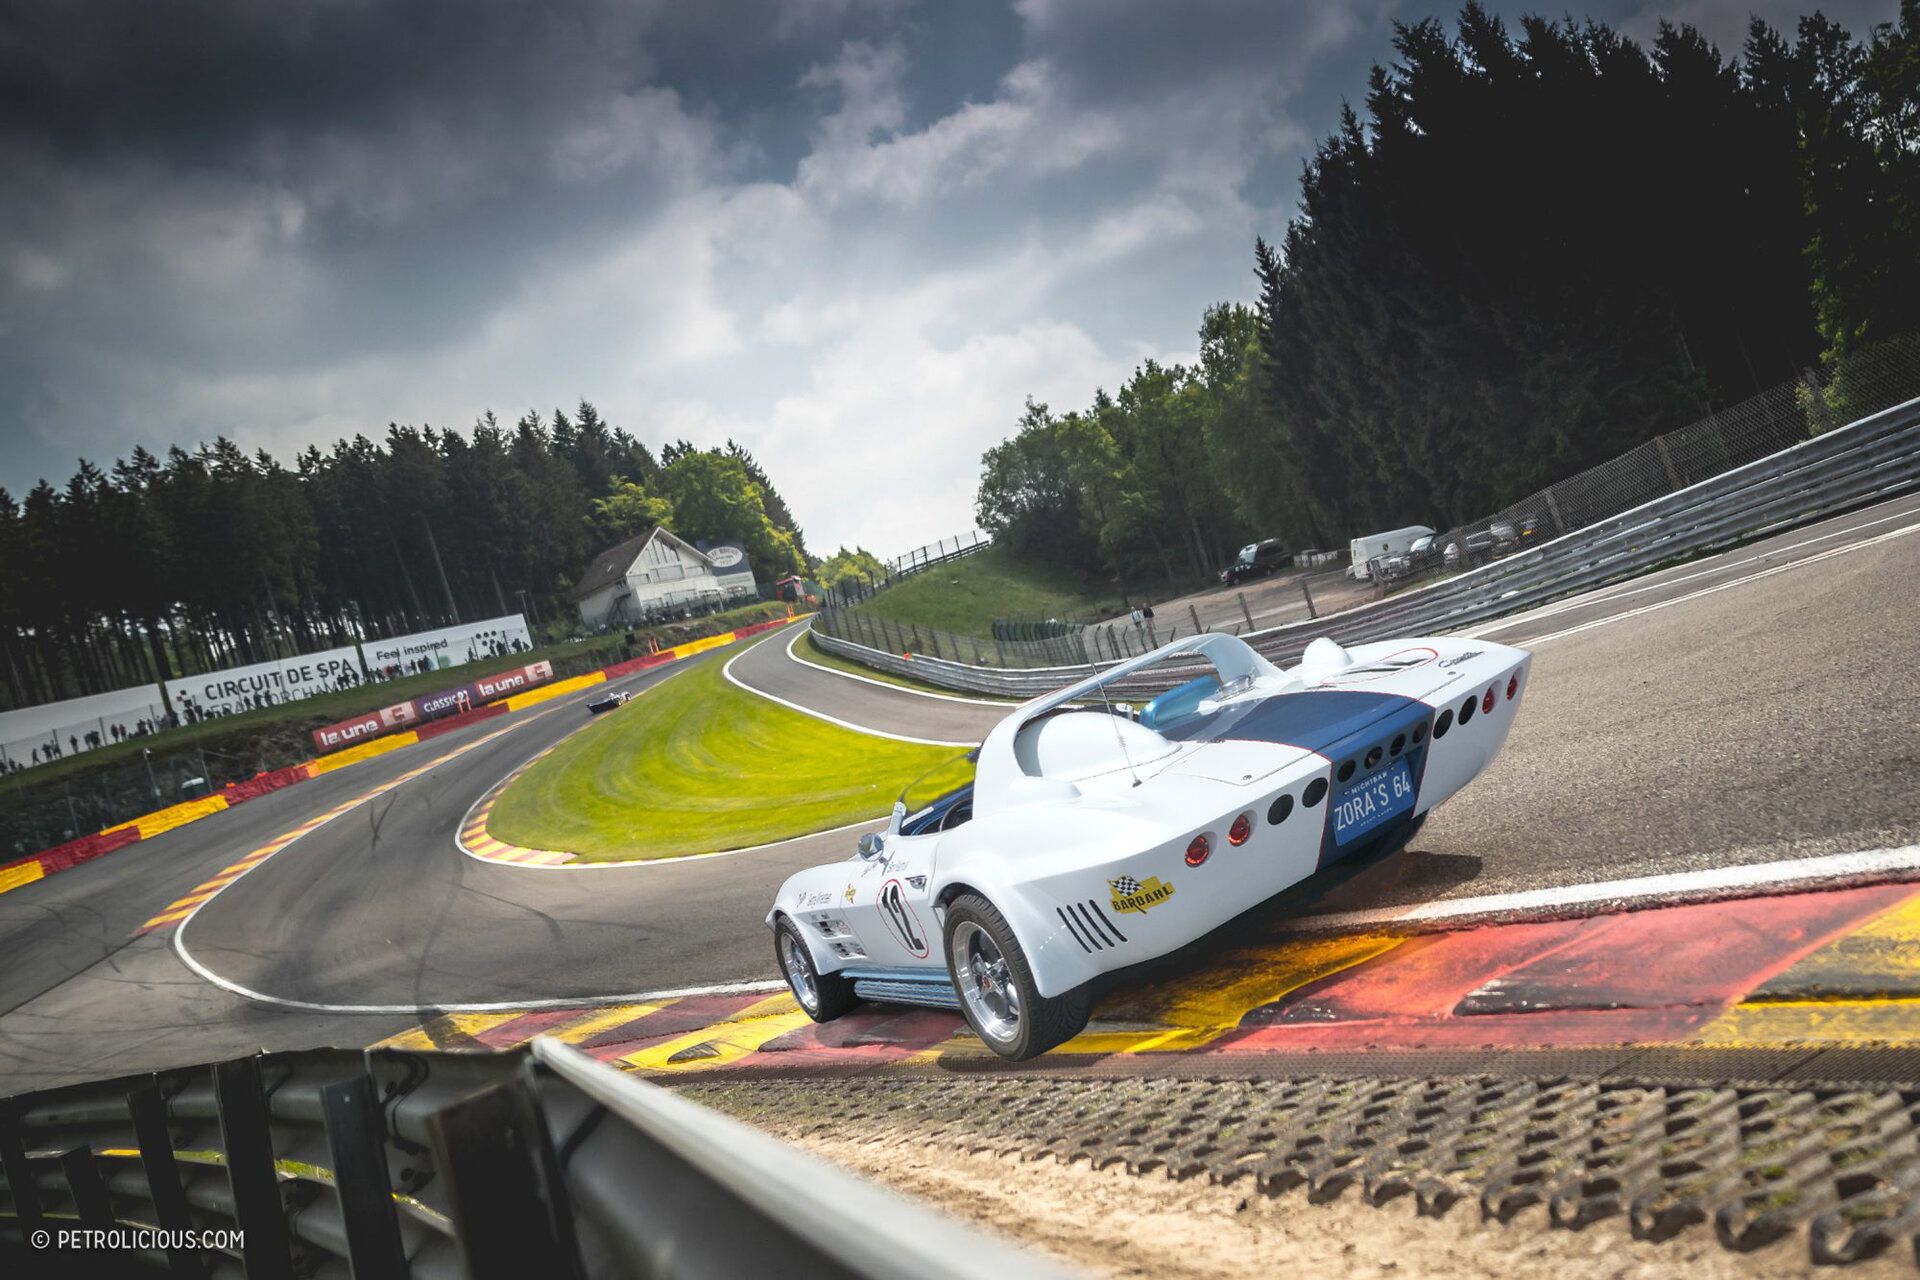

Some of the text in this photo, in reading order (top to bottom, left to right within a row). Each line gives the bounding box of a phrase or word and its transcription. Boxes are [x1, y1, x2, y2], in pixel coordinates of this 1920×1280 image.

[376, 638, 448, 661] Feel inspired
[204, 659, 354, 700] CIRCUIT DE SPA
[478, 683, 495, 696] la
[320, 731, 341, 746] la
[1334, 783, 1389, 831] ZORA'S
[1393, 771, 1411, 798] 64
[1112, 886, 1173, 914] BARDAHL
[881, 884, 925, 950] 12
